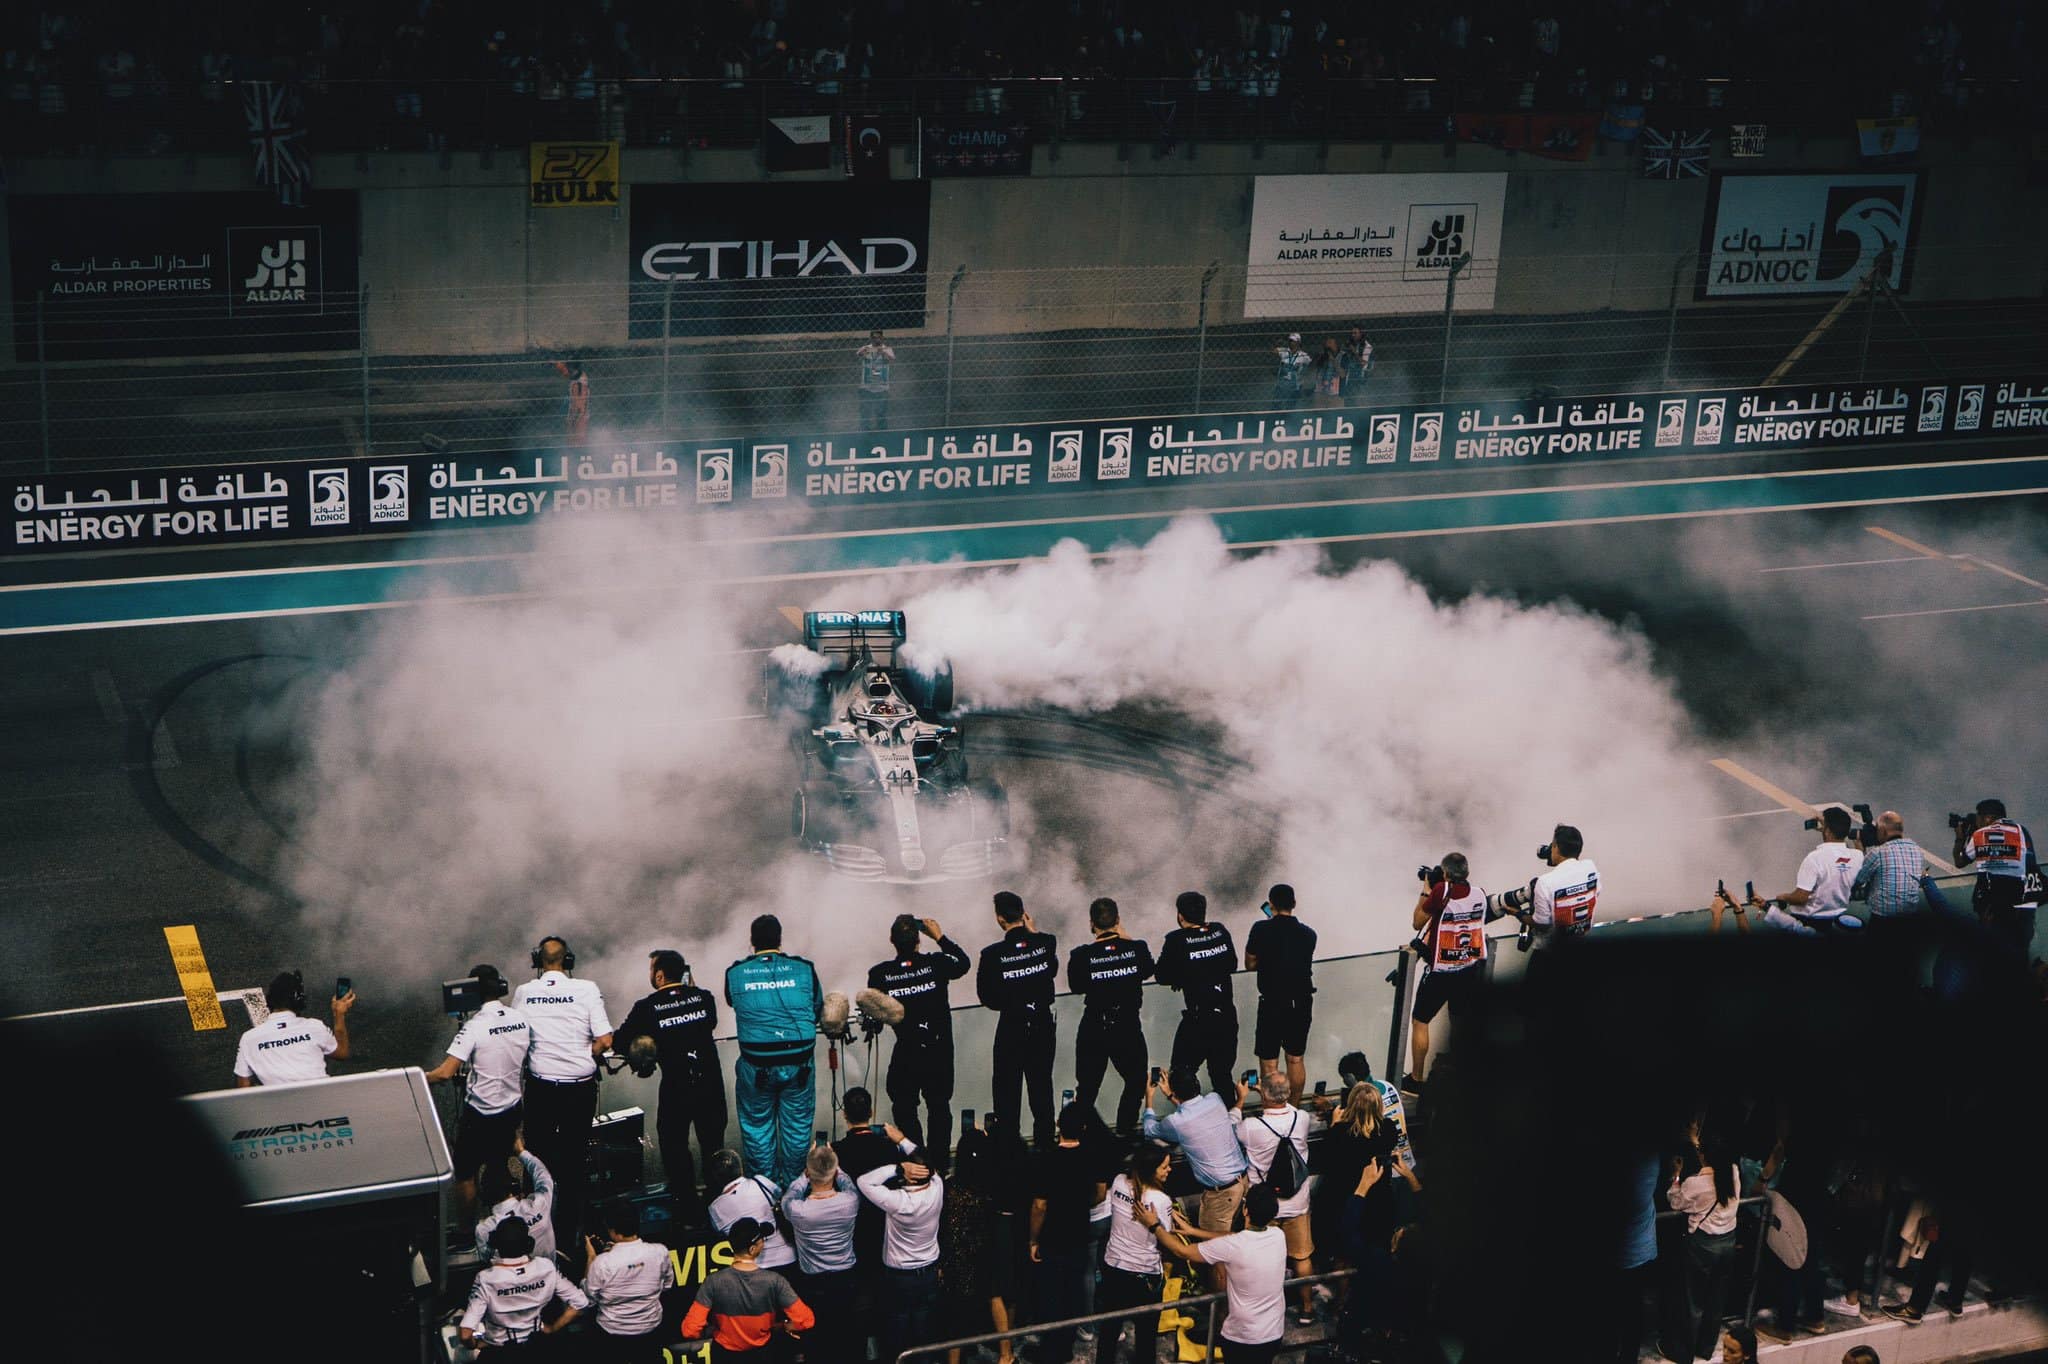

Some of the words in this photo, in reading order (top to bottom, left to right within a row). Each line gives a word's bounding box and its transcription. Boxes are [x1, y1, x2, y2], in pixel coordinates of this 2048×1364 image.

[542, 146, 609, 180] 27
[532, 182, 617, 202] HULK
[641, 238, 918, 280] ETIHAD
[1277, 248, 1318, 261] ALDAR
[1321, 246, 1394, 259] PROPERTIES
[1717, 260, 1809, 283] ADNOC
[53, 281, 107, 295] ALDAR
[113, 278, 212, 293] PROPERTIES
[247, 289, 306, 303] ALDAR
[1818, 416, 1859, 438] FOR
[1863, 414, 1906, 436] LIFE
[1547, 433, 1593, 455] FOR
[1596, 429, 1643, 451] LIFE
[1249, 449, 1299, 472] FOR
[1302, 446, 1353, 468] LIFE
[919, 467, 973, 491] FOR
[977, 463, 1032, 488] LIFE
[1051, 471, 1078, 479] ADNOC
[1101, 468, 1128, 476] ADNOC
[554, 487, 616, 513] FOR
[618, 483, 679, 509] LIFE
[152, 509, 218, 536] FOR
[225, 505, 291, 532] LIFE
[314, 513, 346, 522] ADNOC
[374, 510, 405, 519] ADNOC
[885, 769, 915, 783] 44
[1189, 943, 1228, 960] PETRONAS
[1003, 961, 1048, 979] PETRONAS
[1091, 966, 1138, 980] PETRONAS
[744, 979, 796, 990] PETRONAS
[888, 981, 936, 997] PETRONAS
[526, 996, 575, 1005] PETRONAS
[659, 1010, 707, 1028] PETRONAS
[488, 1022, 526, 1036] PETRONAS
[258, 1033, 311, 1051] PETRONAS
[268, 1116, 350, 1136] AMG
[229, 1127, 353, 1153] ETRONAS
[233, 1138, 354, 1161] MOTORSPORT
[497, 1280, 545, 1296] PETRONAS
